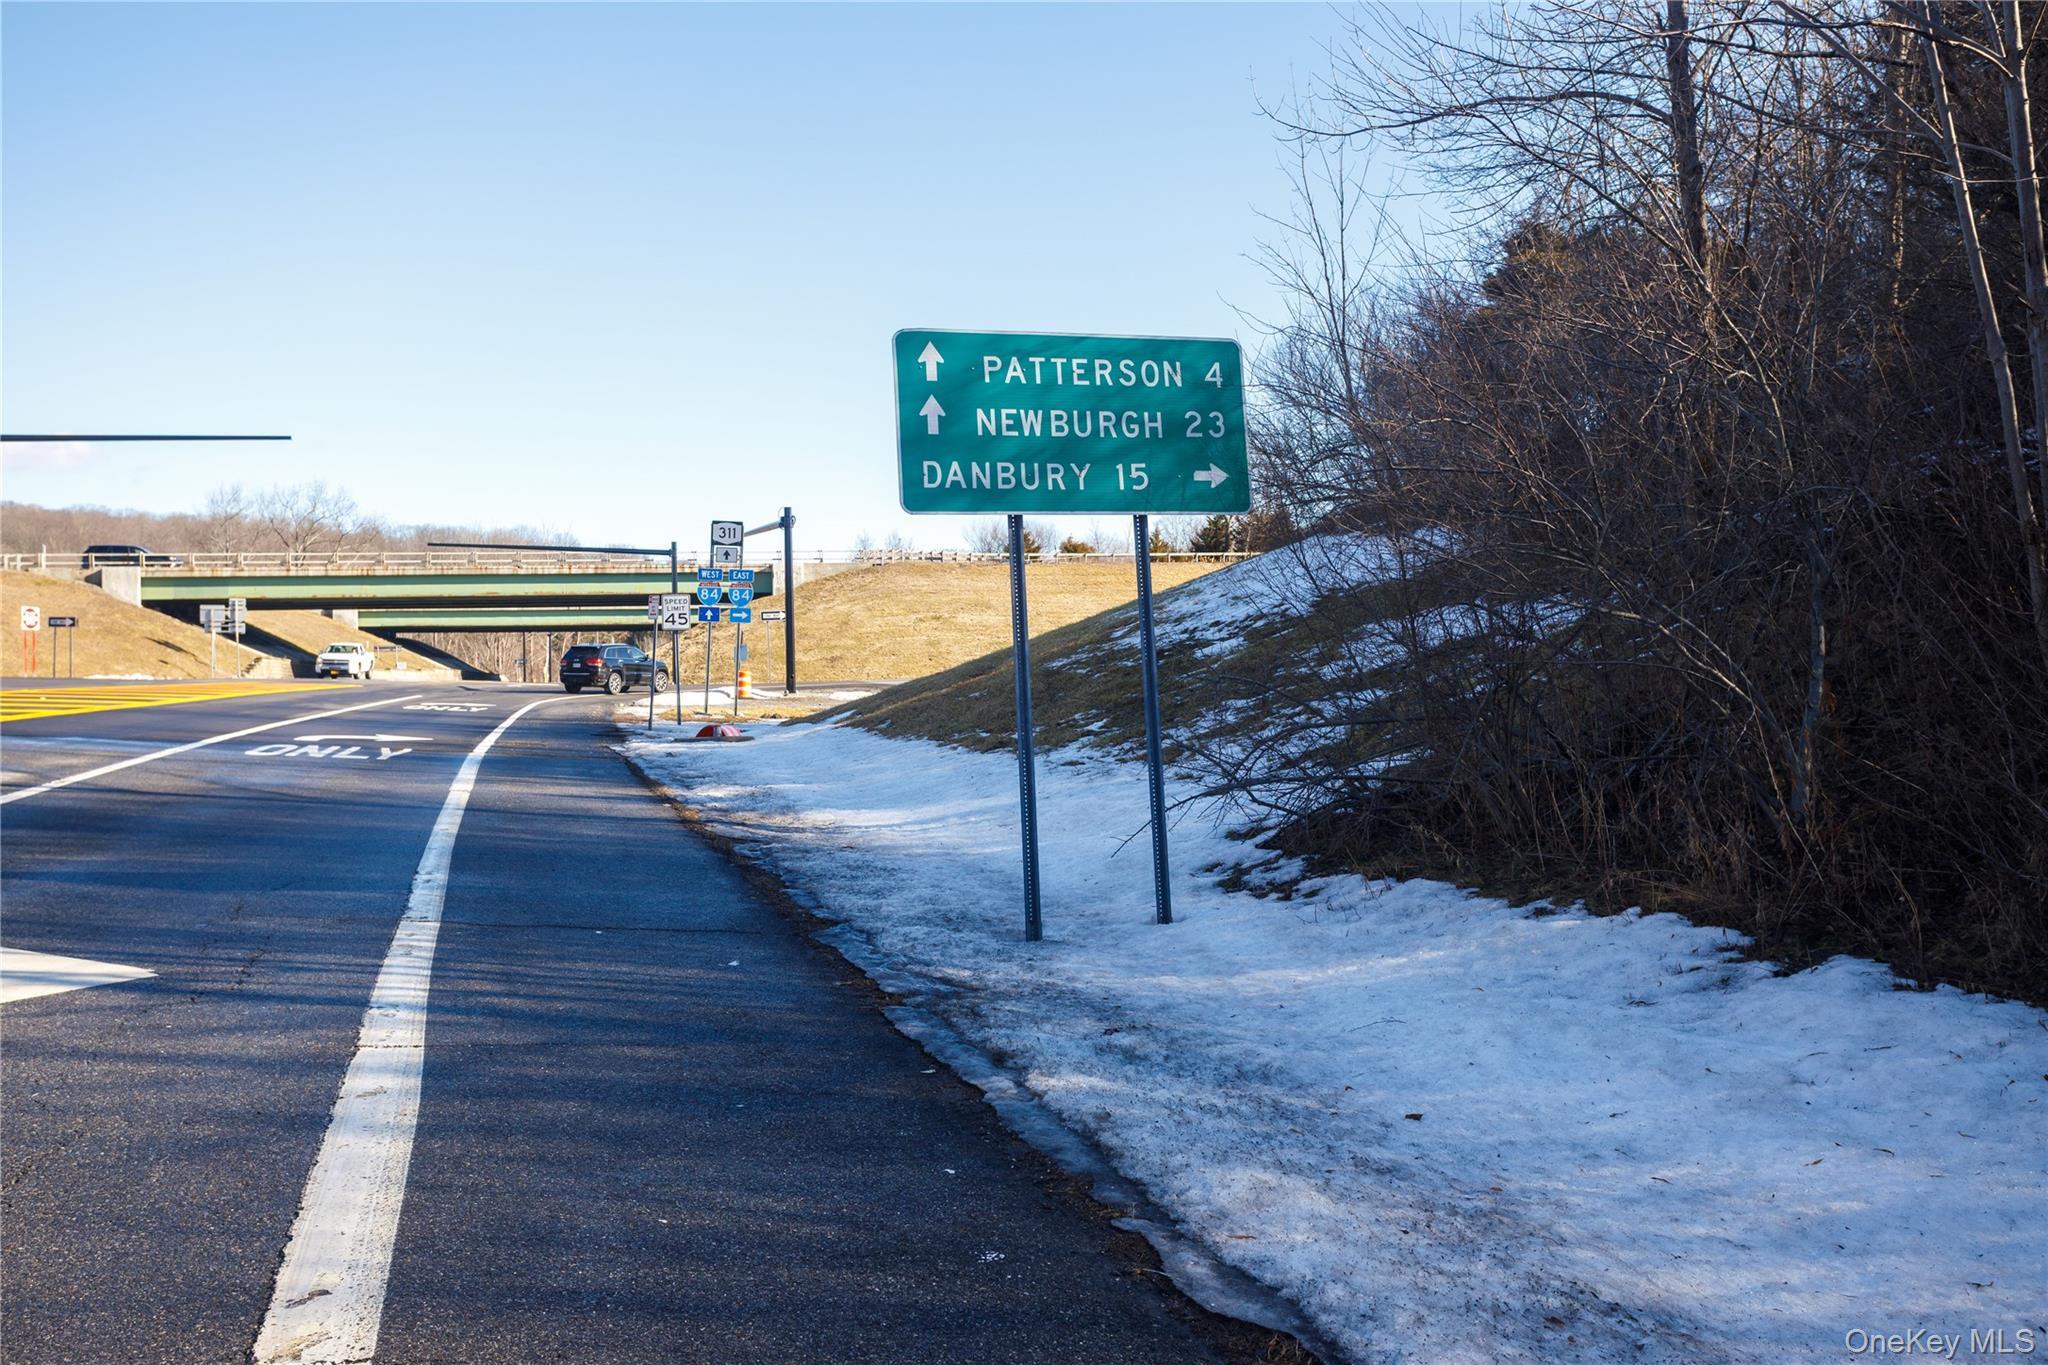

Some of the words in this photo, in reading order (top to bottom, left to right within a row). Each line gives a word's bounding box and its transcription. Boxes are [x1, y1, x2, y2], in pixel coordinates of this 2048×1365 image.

[982, 355, 1184, 387] PATTERSON
[1204, 361, 1223, 389] 4
[976, 408, 1163, 439] NEWBURGH
[1184, 411, 1226, 439] 23
[922, 460, 1091, 490] DANBURY
[1116, 463, 1149, 491] 15
[718, 527, 737, 539] 311
[701, 570, 720, 578] WEST
[733, 571, 750, 579] EAST
[701, 588, 719, 599] 84
[732, 590, 750, 601] 84
[664, 613, 688, 625] 45
[244, 744, 413, 760] ONLY
